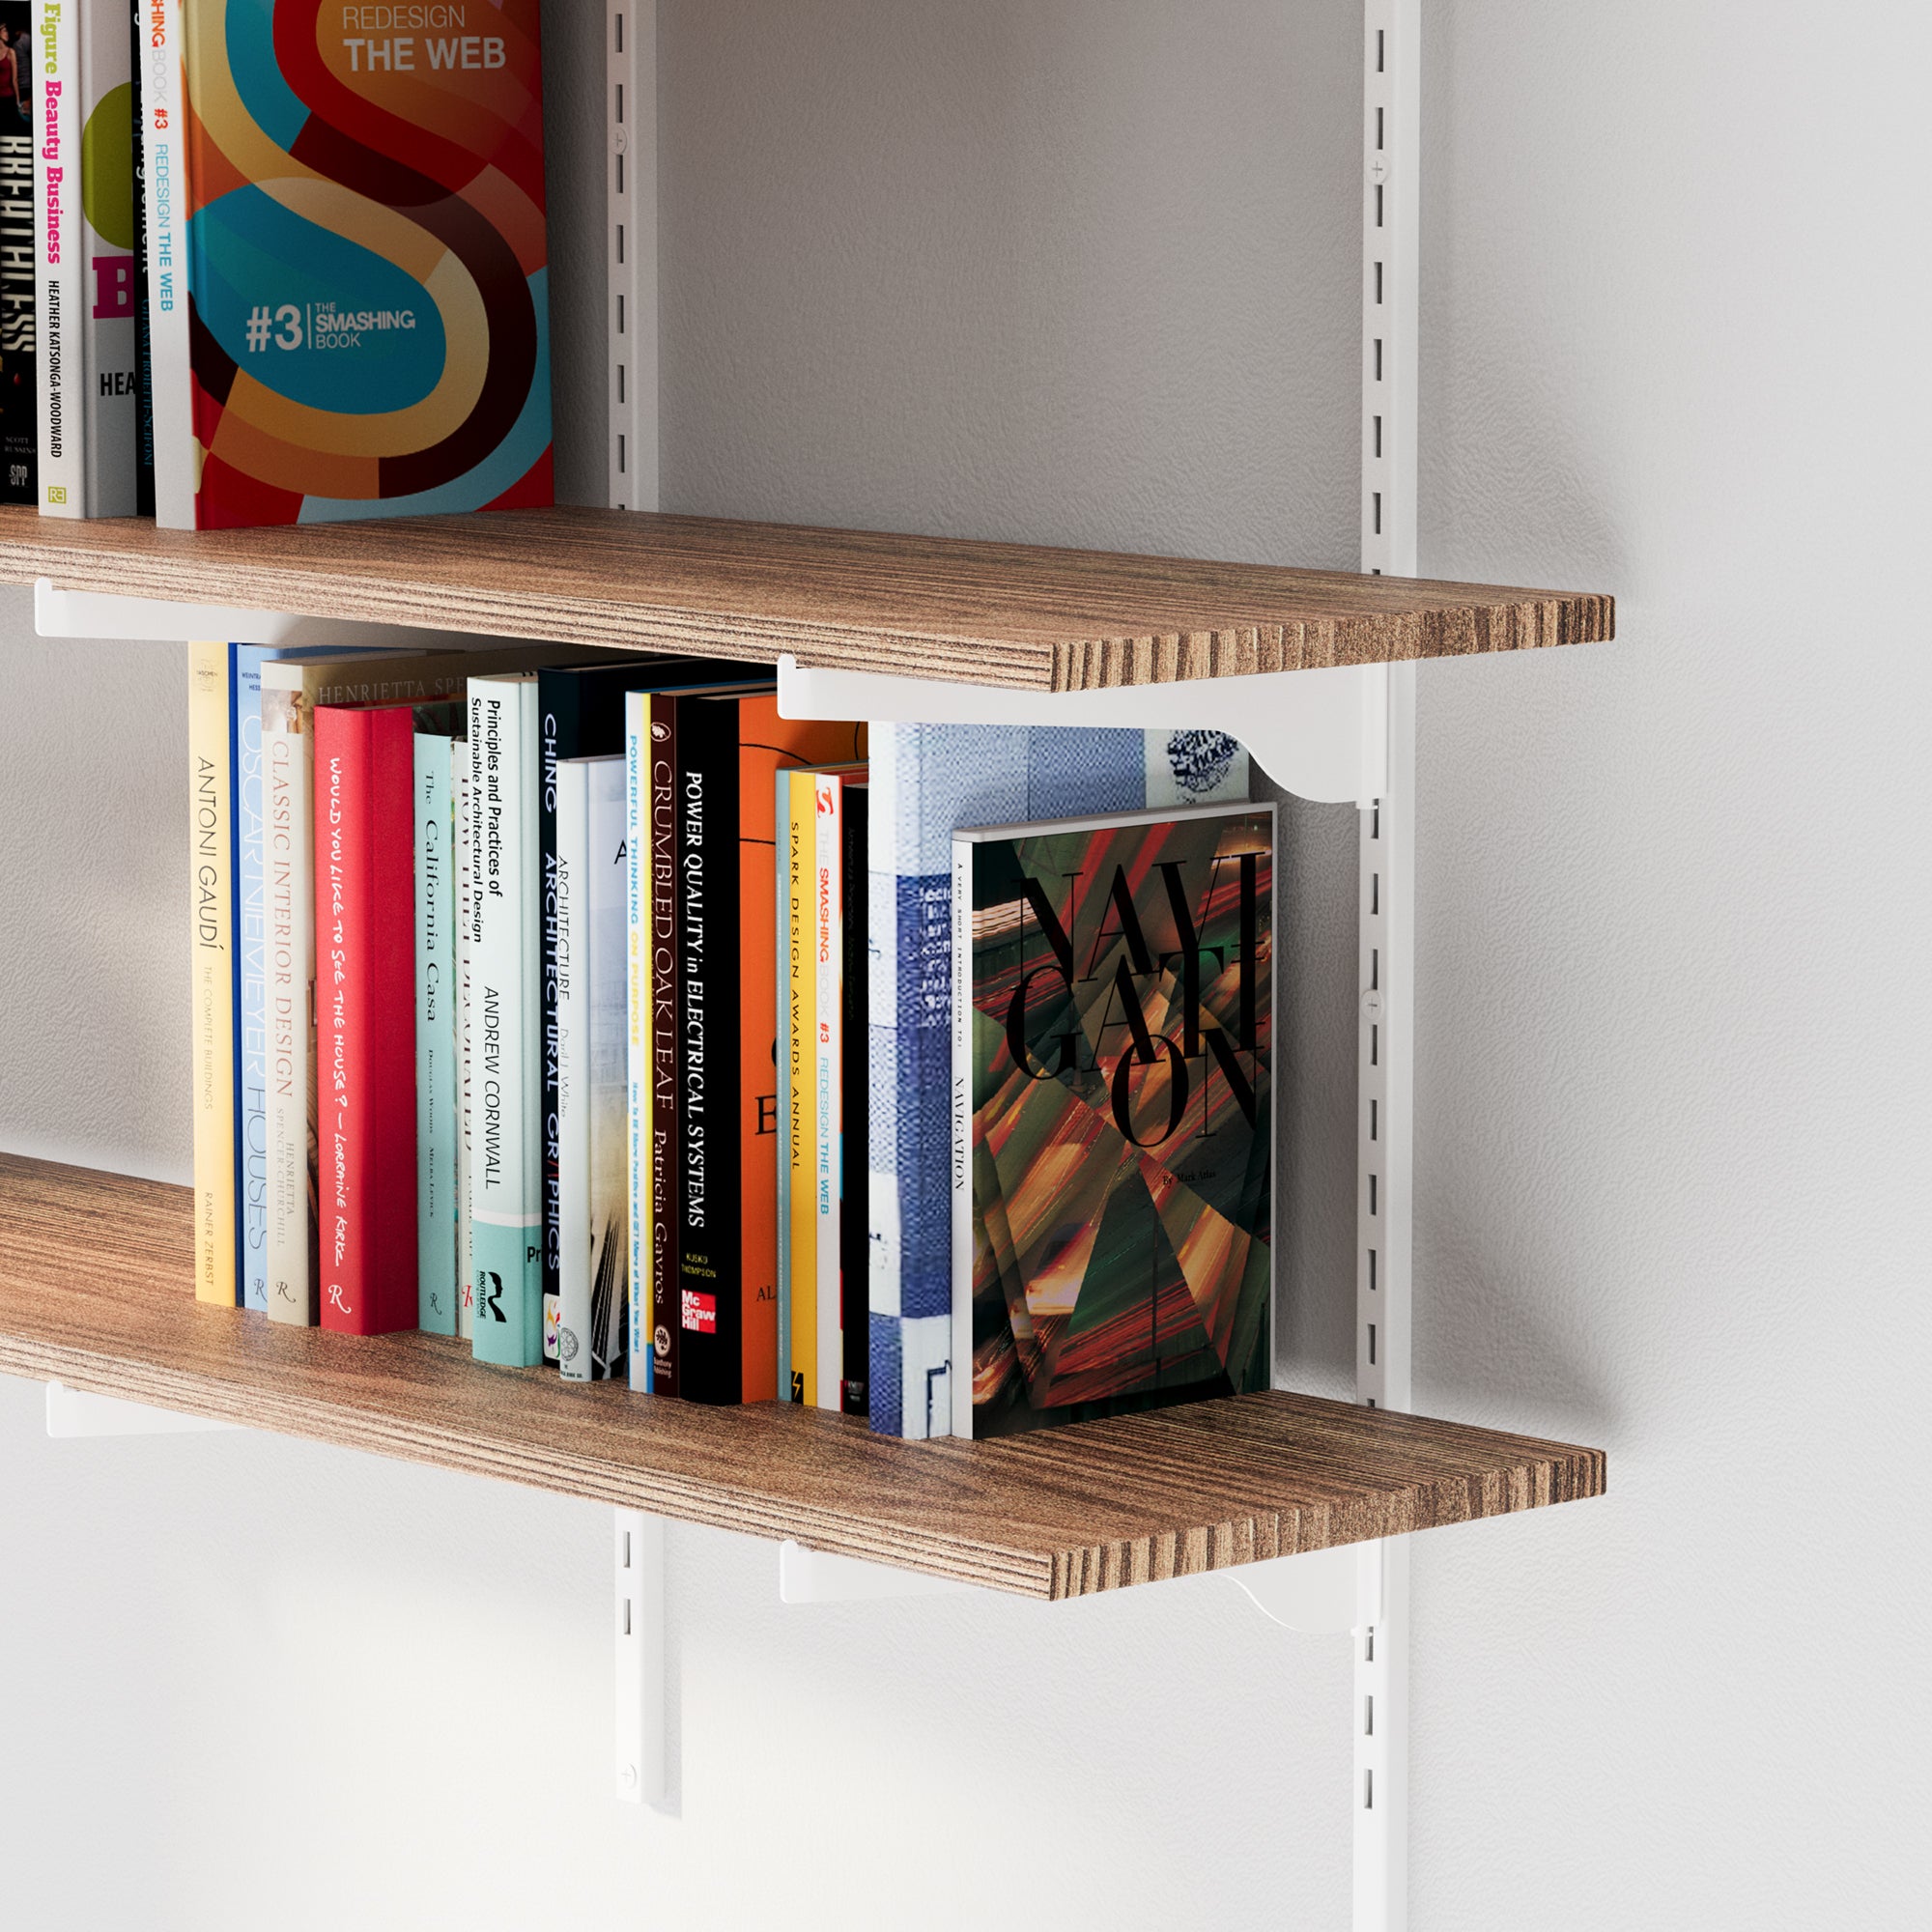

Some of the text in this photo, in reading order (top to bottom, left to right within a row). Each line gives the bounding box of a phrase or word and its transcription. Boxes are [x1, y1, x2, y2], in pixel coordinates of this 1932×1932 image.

[343, 5, 466, 30] REDESIGN
[152, 49, 167, 102] BOOK
[343, 37, 506, 71] THE WEB
[41, 3, 64, 265] Figure Beauty Business
[154, 108, 168, 129] #3
[155, 144, 171, 228] REDESIGN
[158, 233, 172, 267] THE
[159, 272, 174, 312] WEB
[315, 302, 336, 313] THE
[245, 304, 303, 353] #3
[315, 310, 415, 332] SMASHING
[316, 332, 361, 350] BOOK
[48, 280, 62, 458] HEATHER KATSONGA-WOODWARD
[319, 680, 426, 704] HENRIETTA
[425, 771, 435, 805] The
[544, 714, 556, 813] CHING
[329, 757, 343, 824] WOULD
[486, 699, 503, 897] Principles and Practices of
[330, 828, 343, 861] YOU
[471, 697, 484, 943] Sustainable Architectural Design
[330, 865, 343, 916] LIKE
[425, 819, 440, 952] California
[629, 735, 639, 1046] POWERFUL THINKING ON PURPOSE
[271, 741, 293, 1098] CLASSIC INTERIOR DESIGN
[331, 920, 343, 944] TO
[558, 855, 570, 1001] ARCHITECTURE
[819, 867, 830, 963] SMASHING
[242, 716, 268, 1250] OSCAR NIEMEYER HOUSES
[331, 950, 345, 985] SEE
[425, 962, 439, 1023] Casa
[545, 852, 559, 1092] ARCHITECTURAL
[819, 964, 830, 1016] BOOK
[198, 756, 224, 1287] ANTONI GAUDÍ THE COMPLETE BUILDINGS RAINER ZERBST
[333, 990, 346, 1028] THE
[684, 771, 704, 1228] POWER QUALITY in ELECTRICAL SYSTEMS
[791, 822, 800, 1170] SPARK DESIGN AWARDS ANNUAL
[654, 759, 674, 1304] CRUMBLED OAK LEAF Patricia Gavros
[819, 1022, 830, 1043] #3
[484, 986, 500, 1189] ANDREW CORNWALL
[559, 1076, 570, 1118] White
[819, 1057, 830, 1138] REDESIGN
[819, 1142, 829, 1175] THE
[954, 1076, 965, 1192] NAVIGATION
[285, 1143, 296, 1215] HENRIETTA
[334, 1133, 350, 1208] LORRAINE
[1162, 1175, 1174, 1189] By
[819, 1179, 830, 1215] WEB
[335, 1215, 348, 1266] KIRKE
[682, 1289, 700, 1306] Mc
[682, 1304, 717, 1321] Graw
[682, 1315, 699, 1331] Hill
